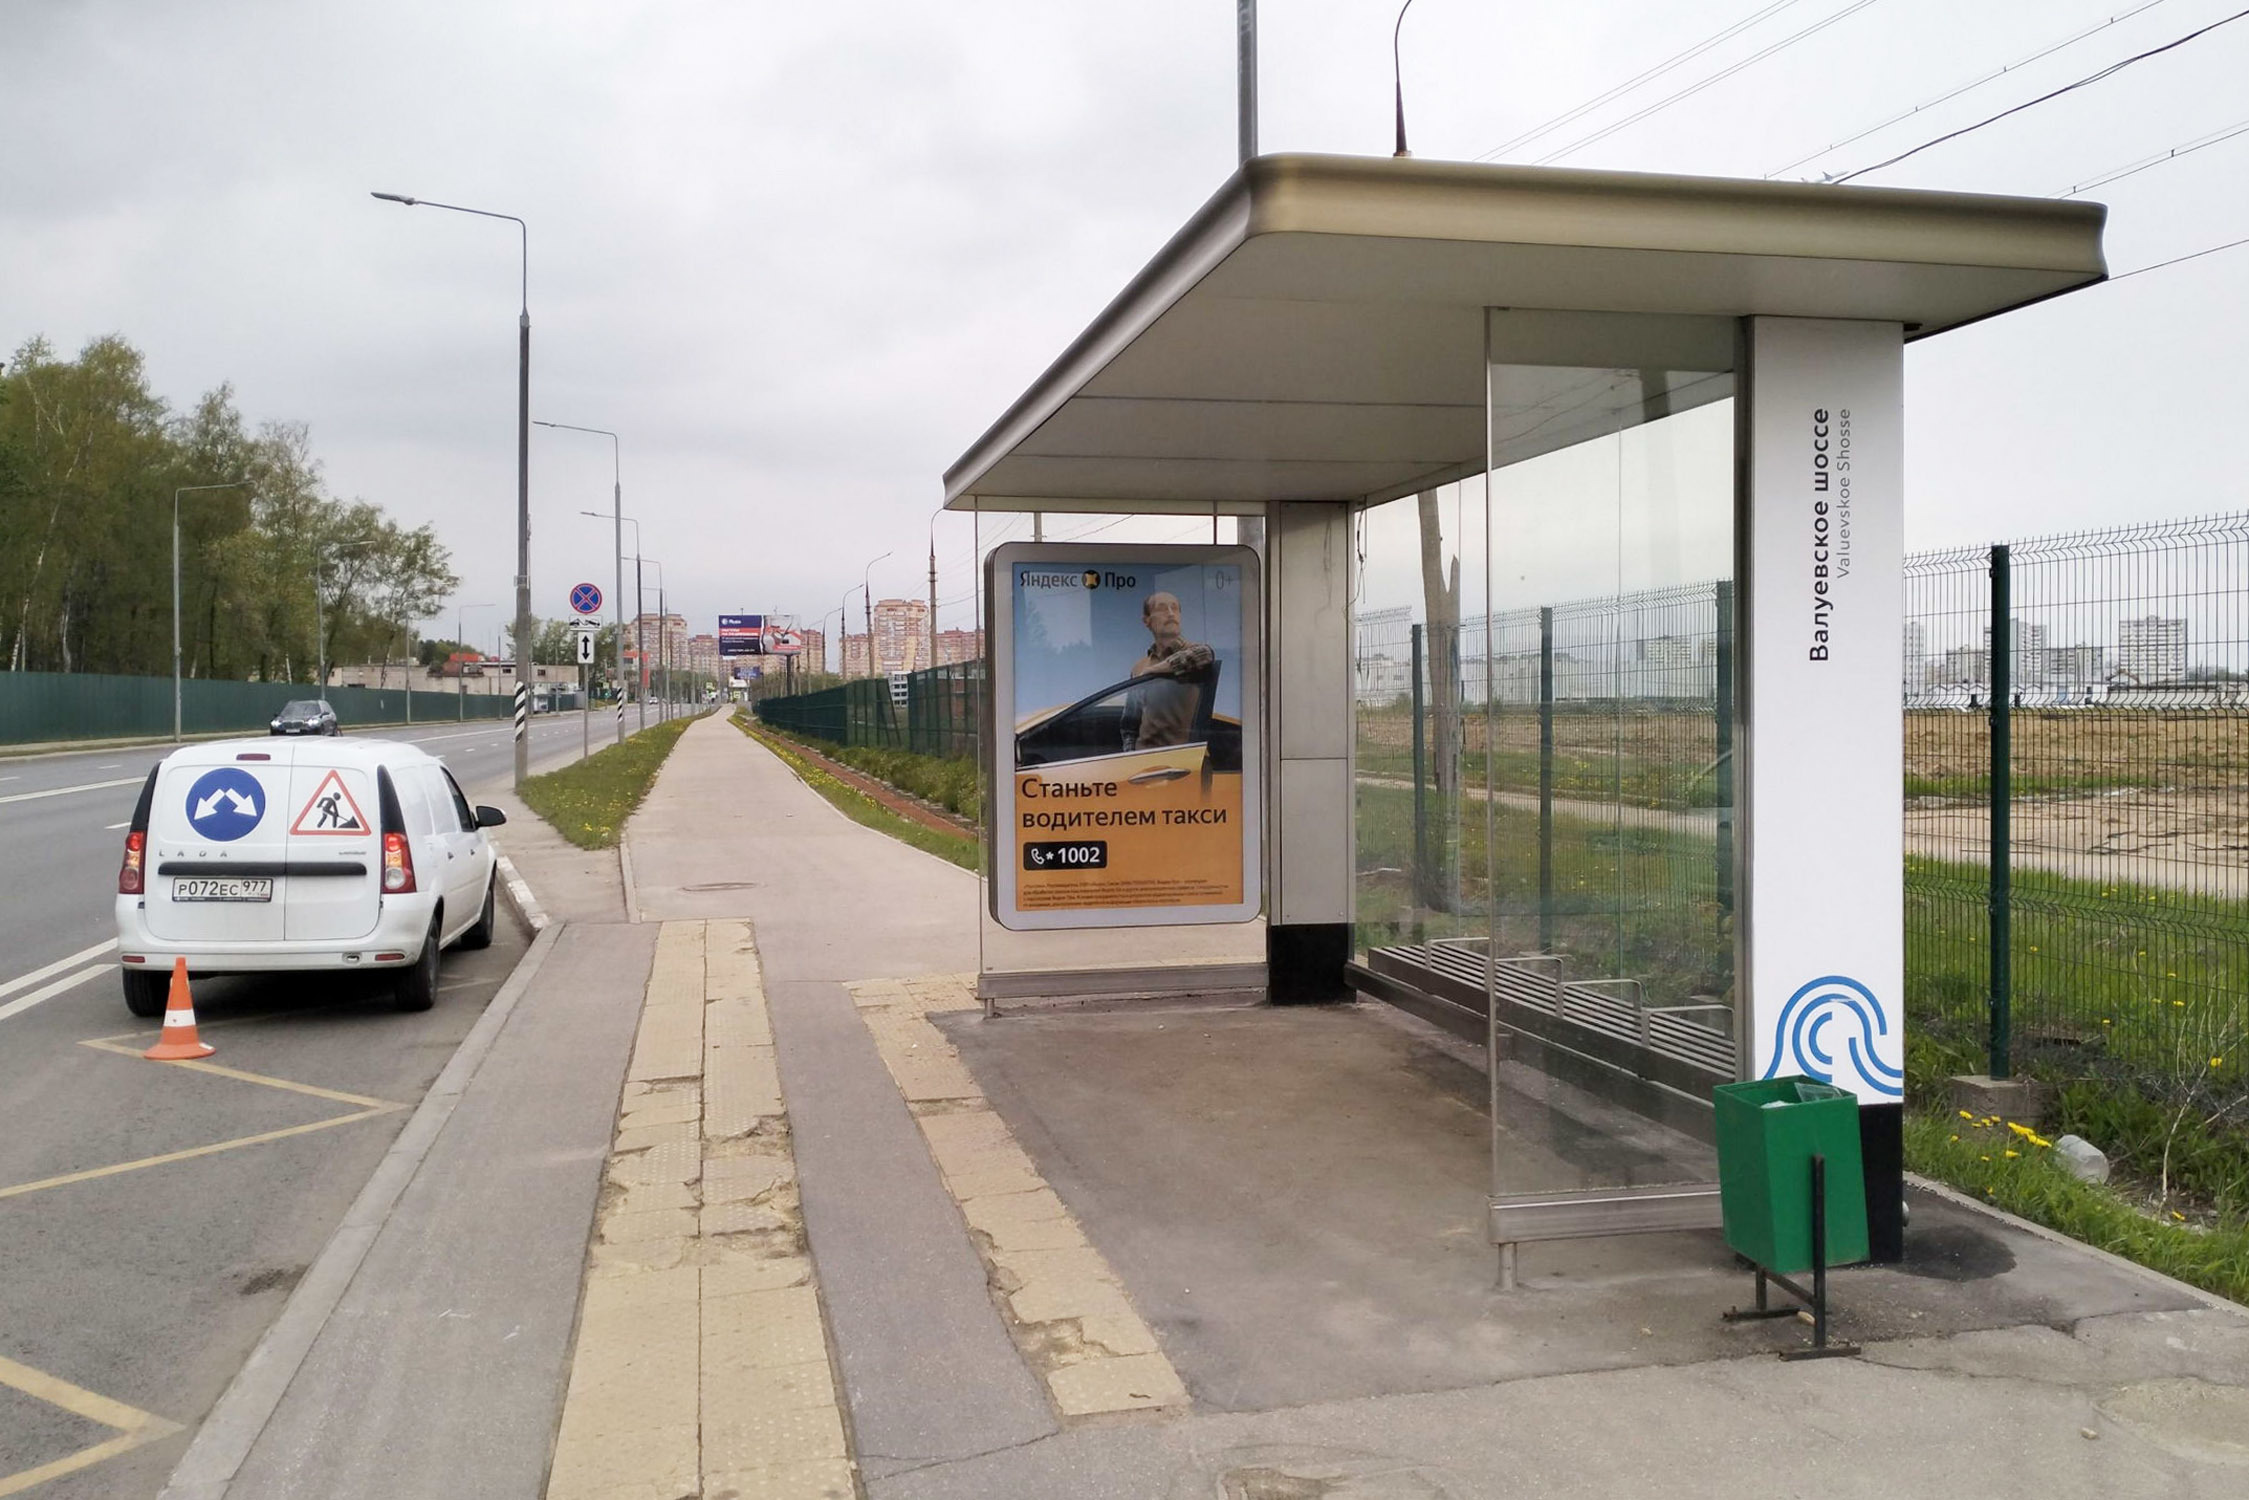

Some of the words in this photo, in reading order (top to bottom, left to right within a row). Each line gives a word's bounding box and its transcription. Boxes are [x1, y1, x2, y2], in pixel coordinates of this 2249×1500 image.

[1814, 408, 1829, 492] шоссе
[1836, 408, 1851, 472] Shosse
[1836, 477, 1851, 579] Valuevskoe
[1020, 571, 1078, 589] Яндекс
[1105, 571, 1136, 590] Про
[1215, 571, 1234, 590] 0+
[1809, 501, 1834, 661] Валуевское
[1021, 778, 1118, 799] Станьте
[1022, 810, 1156, 831] водителем
[1162, 808, 1227, 825] такси
[242, 880, 267, 893] 977
